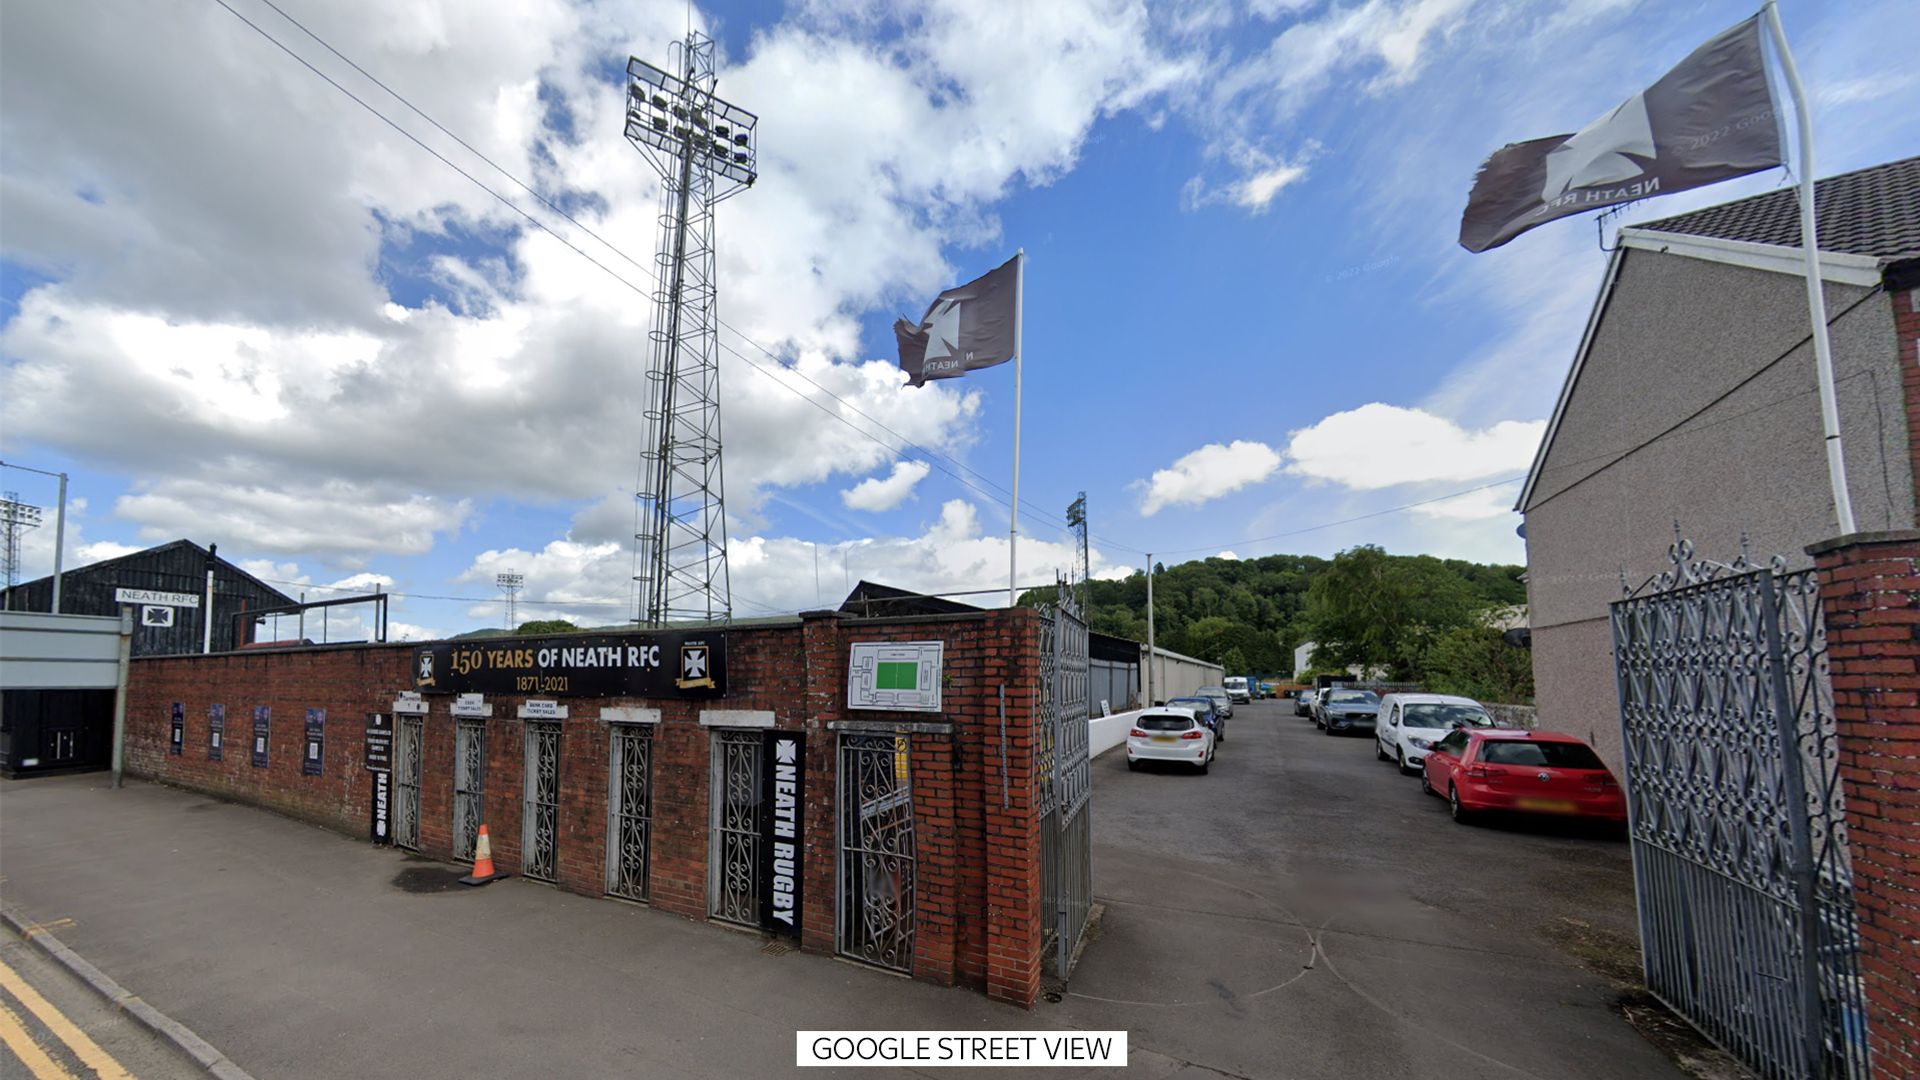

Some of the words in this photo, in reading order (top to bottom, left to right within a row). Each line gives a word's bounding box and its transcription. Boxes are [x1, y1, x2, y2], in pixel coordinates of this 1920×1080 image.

[121, 590, 168, 601] NEATH
[172, 594, 199, 604] RFC
[450, 649, 483, 675] 150
[486, 650, 534, 668] YEARS
[537, 648, 558, 668] OF
[561, 646, 622, 668] NEATH
[627, 645, 660, 668] RFC
[516, 676, 568, 692] 1871-2021
[376, 773, 388, 820] NEATH
[775, 765, 796, 838] NEATH
[773, 842, 795, 926] RUGBY
